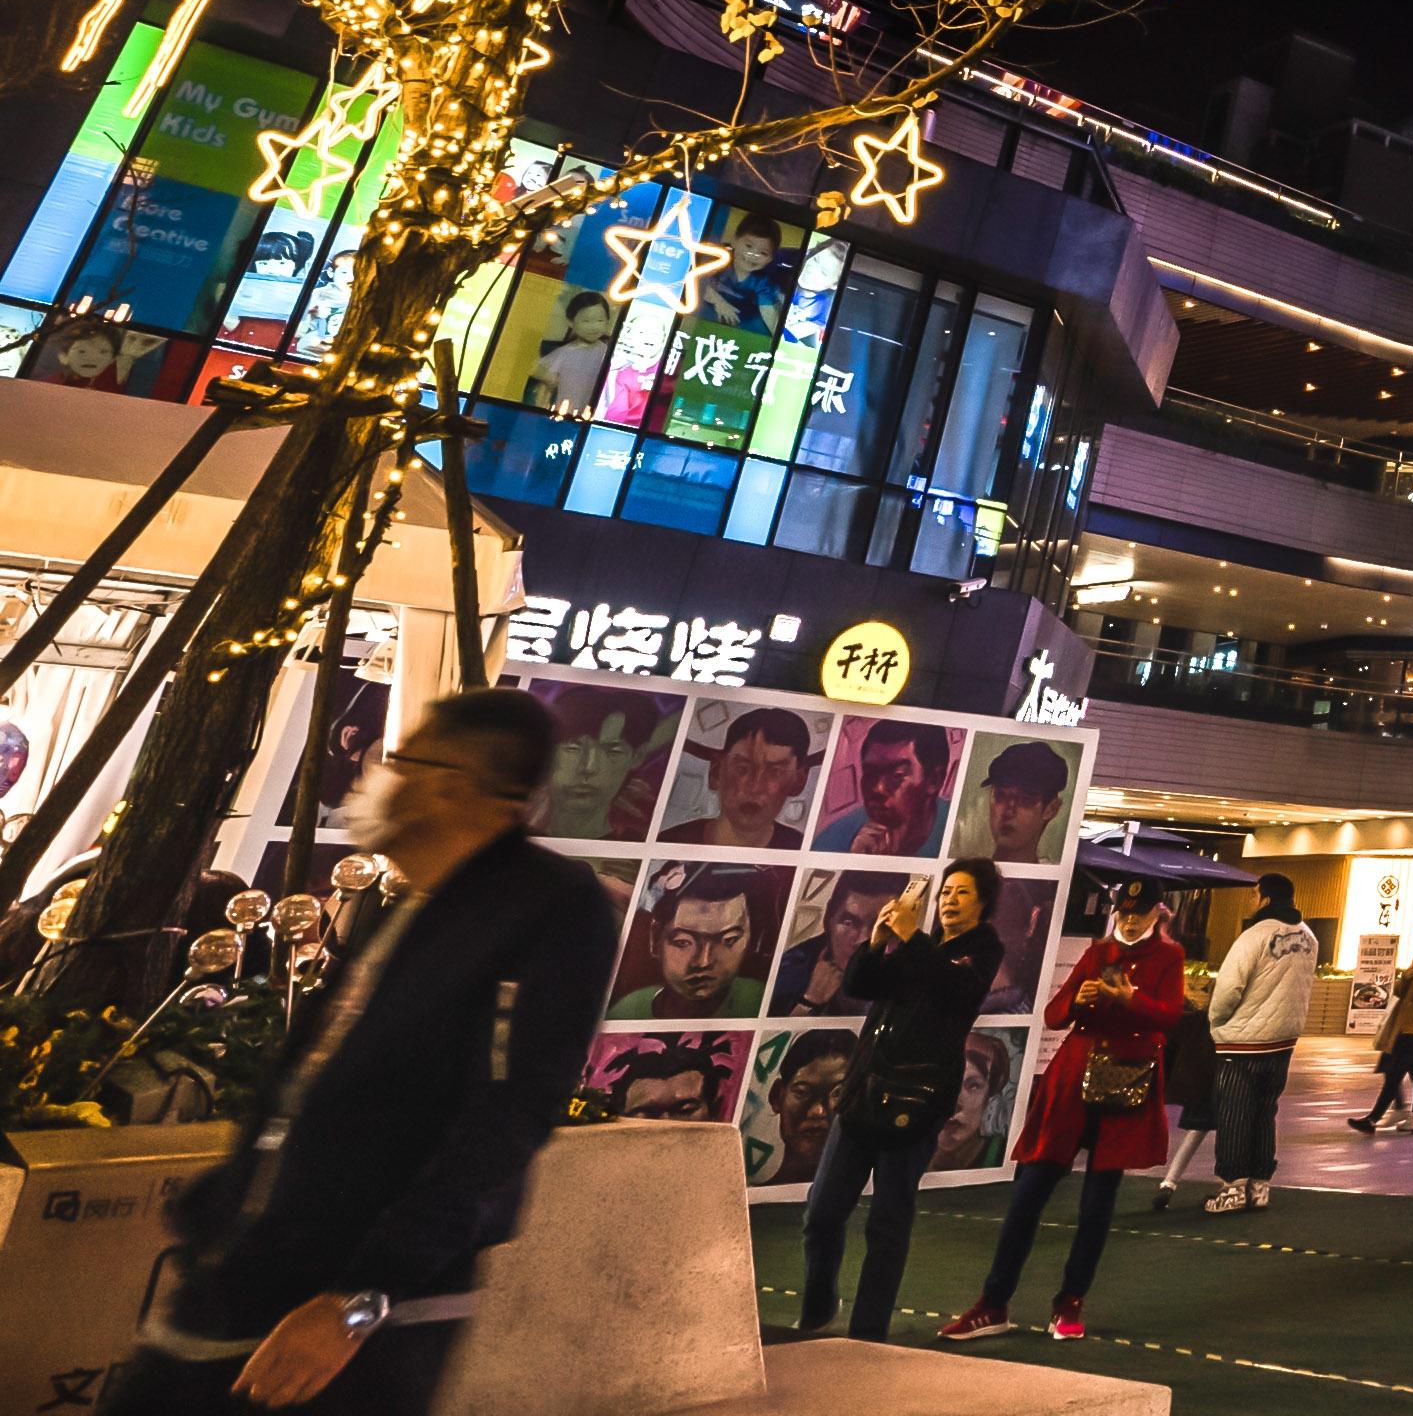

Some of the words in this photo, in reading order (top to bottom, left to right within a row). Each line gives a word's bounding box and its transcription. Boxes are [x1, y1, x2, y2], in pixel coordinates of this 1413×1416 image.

[175, 79, 224, 114] My
[232, 96, 301, 133] Gym
[157, 111, 228, 148] Kids
[836, 642, 899, 684] 干杯
